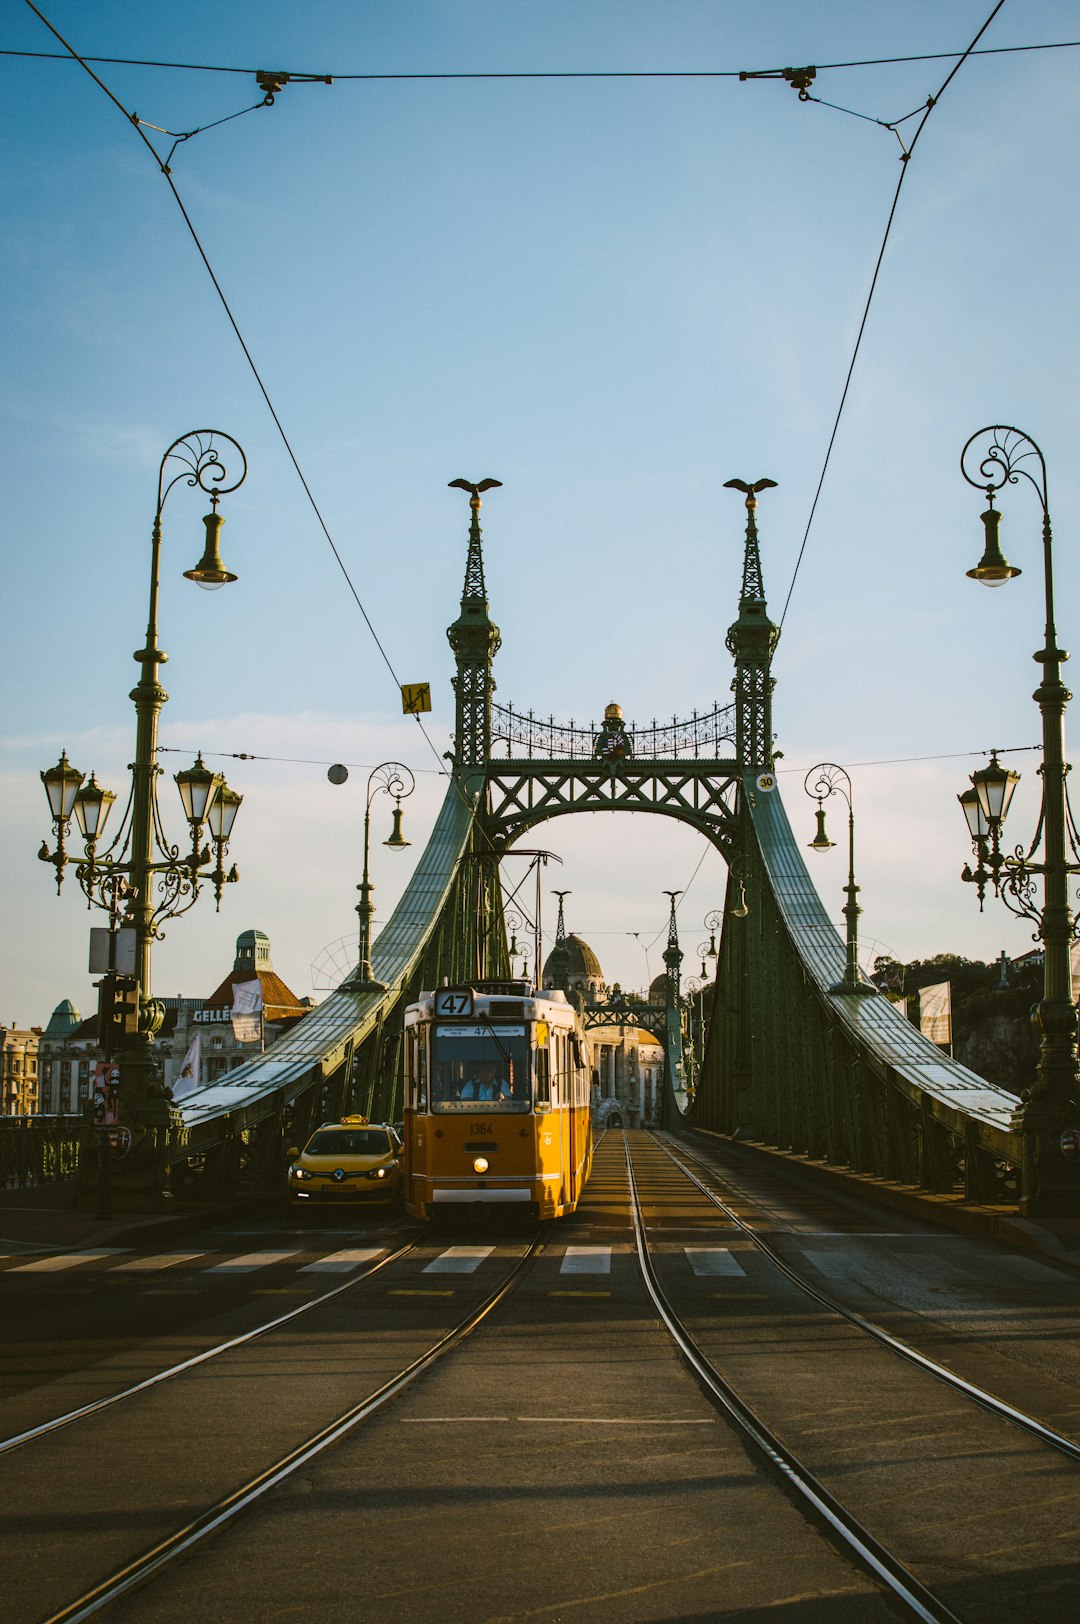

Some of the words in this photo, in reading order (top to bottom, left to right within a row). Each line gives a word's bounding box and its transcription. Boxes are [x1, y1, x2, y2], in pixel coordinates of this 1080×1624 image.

[760, 778, 773, 786] 30
[441, 995, 469, 1013] 47
[193, 1005, 233, 1022] GELLÉ
[470, 1122, 493, 1135] 1364
